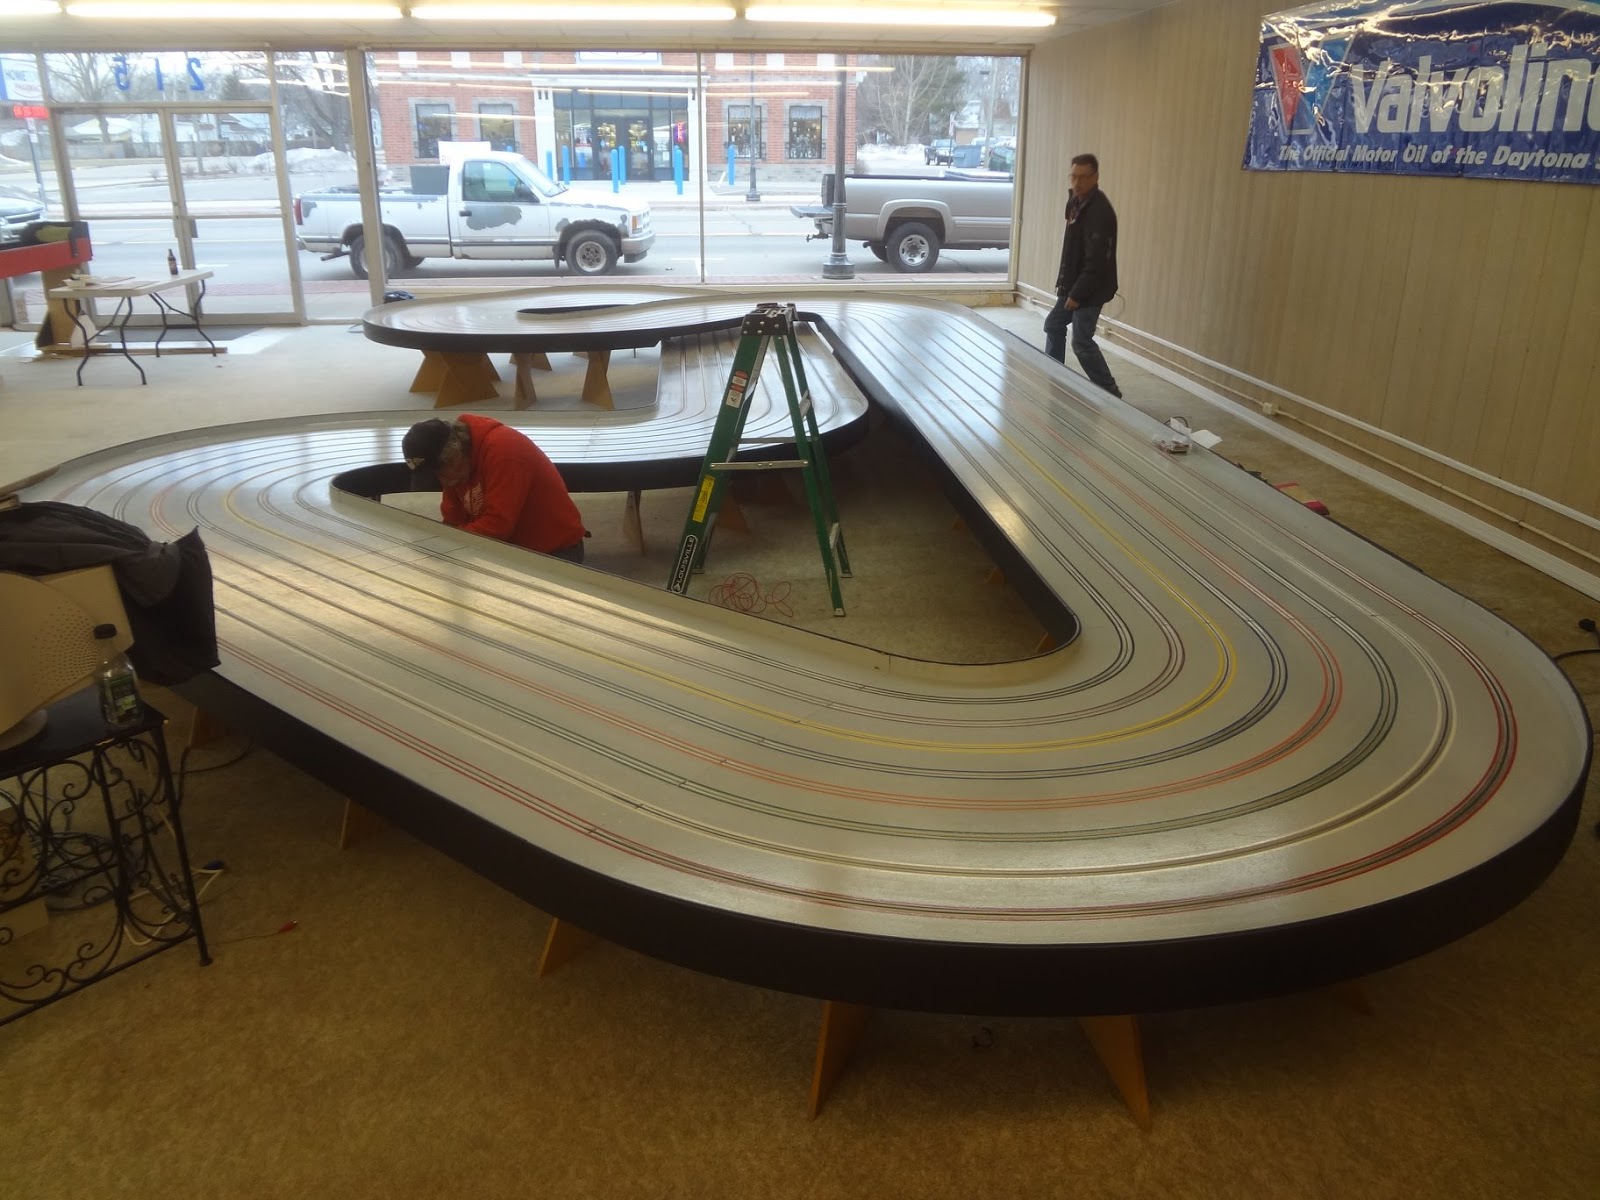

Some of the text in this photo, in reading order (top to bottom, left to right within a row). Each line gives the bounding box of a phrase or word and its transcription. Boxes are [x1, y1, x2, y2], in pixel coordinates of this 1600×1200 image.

[1351, 43, 1600, 133] Valvolin
[1279, 145, 1300, 160] The
[1303, 145, 1348, 161] Official
[1352, 145, 1399, 163] Motor
[1403, 144, 1426, 163] Oil
[1432, 145, 1451, 164] of
[1455, 147, 1487, 165] the
[1492, 146, 1590, 170] Daytona
[677, 538, 694, 582] LOUISVILLE
